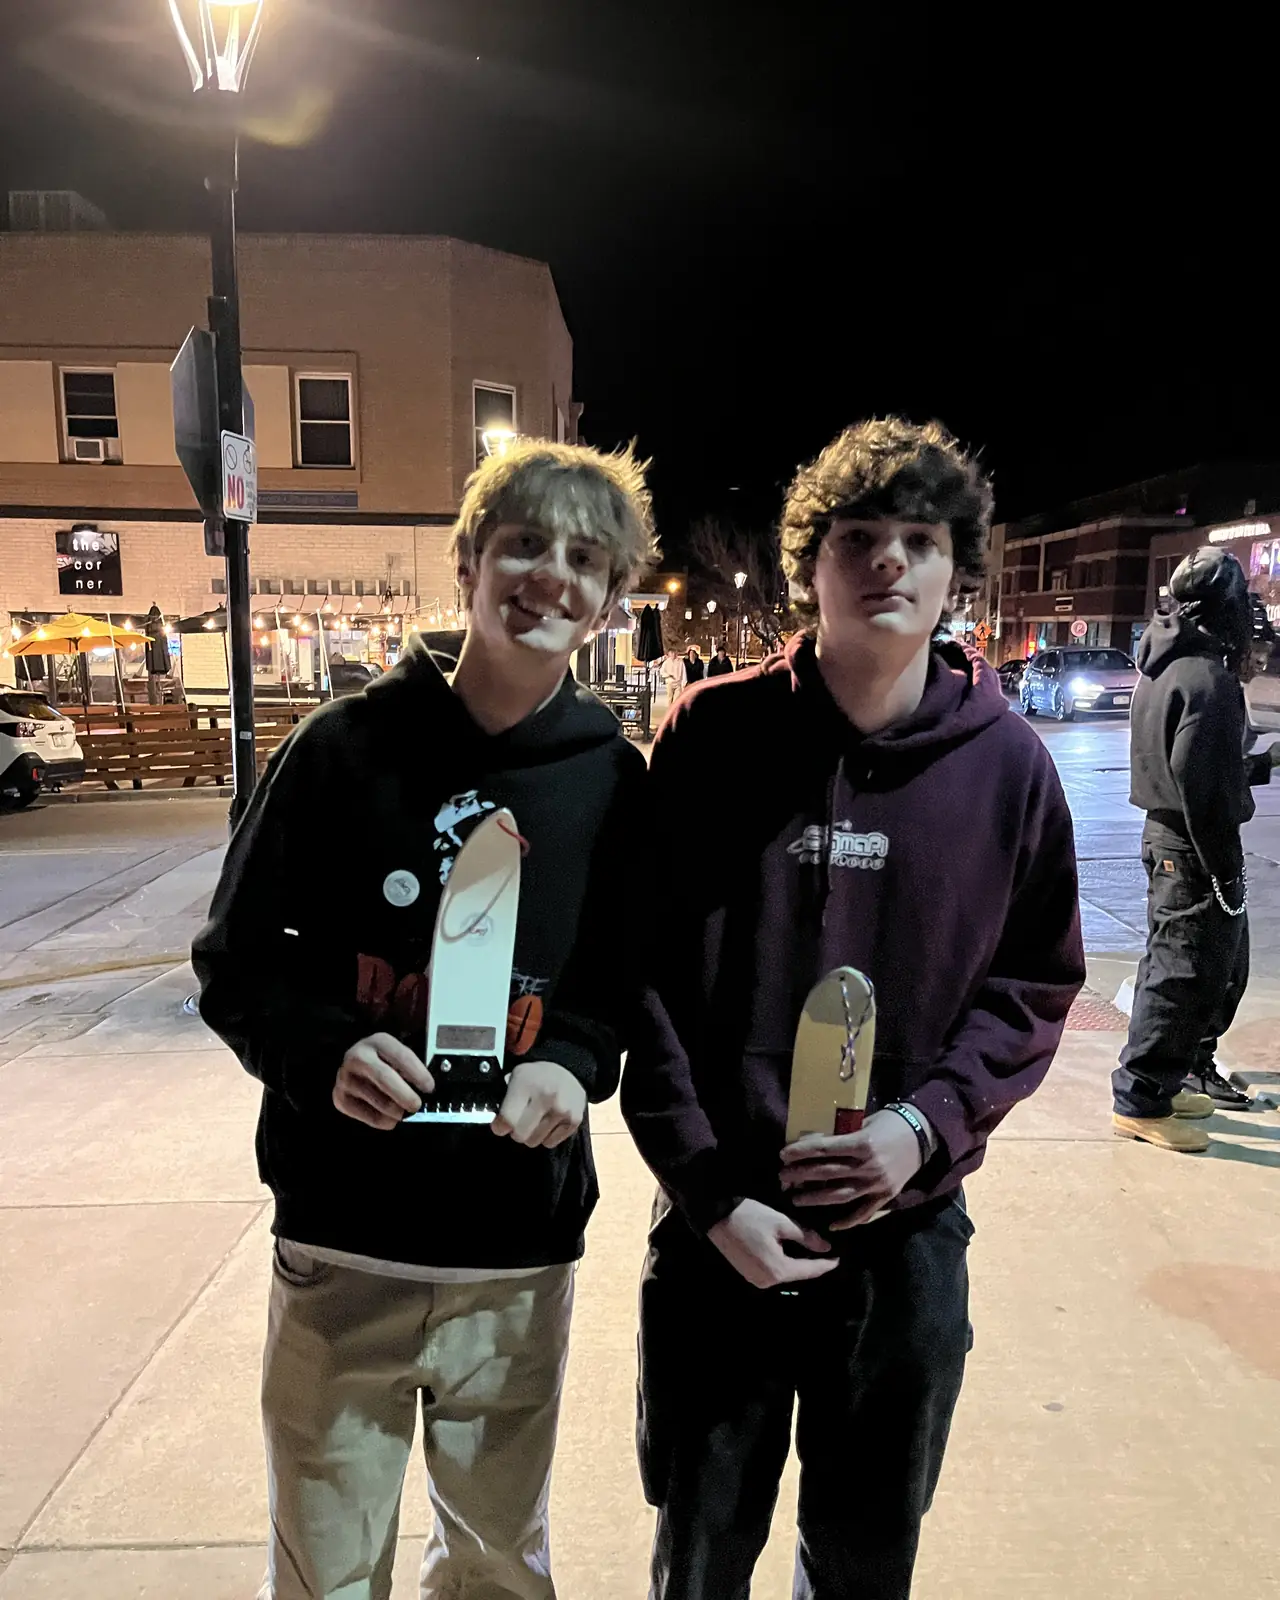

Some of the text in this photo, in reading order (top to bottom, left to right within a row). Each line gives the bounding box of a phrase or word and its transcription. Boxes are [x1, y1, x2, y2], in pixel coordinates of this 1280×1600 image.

[227, 473, 245, 510] NO
[73, 538, 99, 551] the
[74, 561, 102, 570] cor
[75, 579, 103, 589] ner
